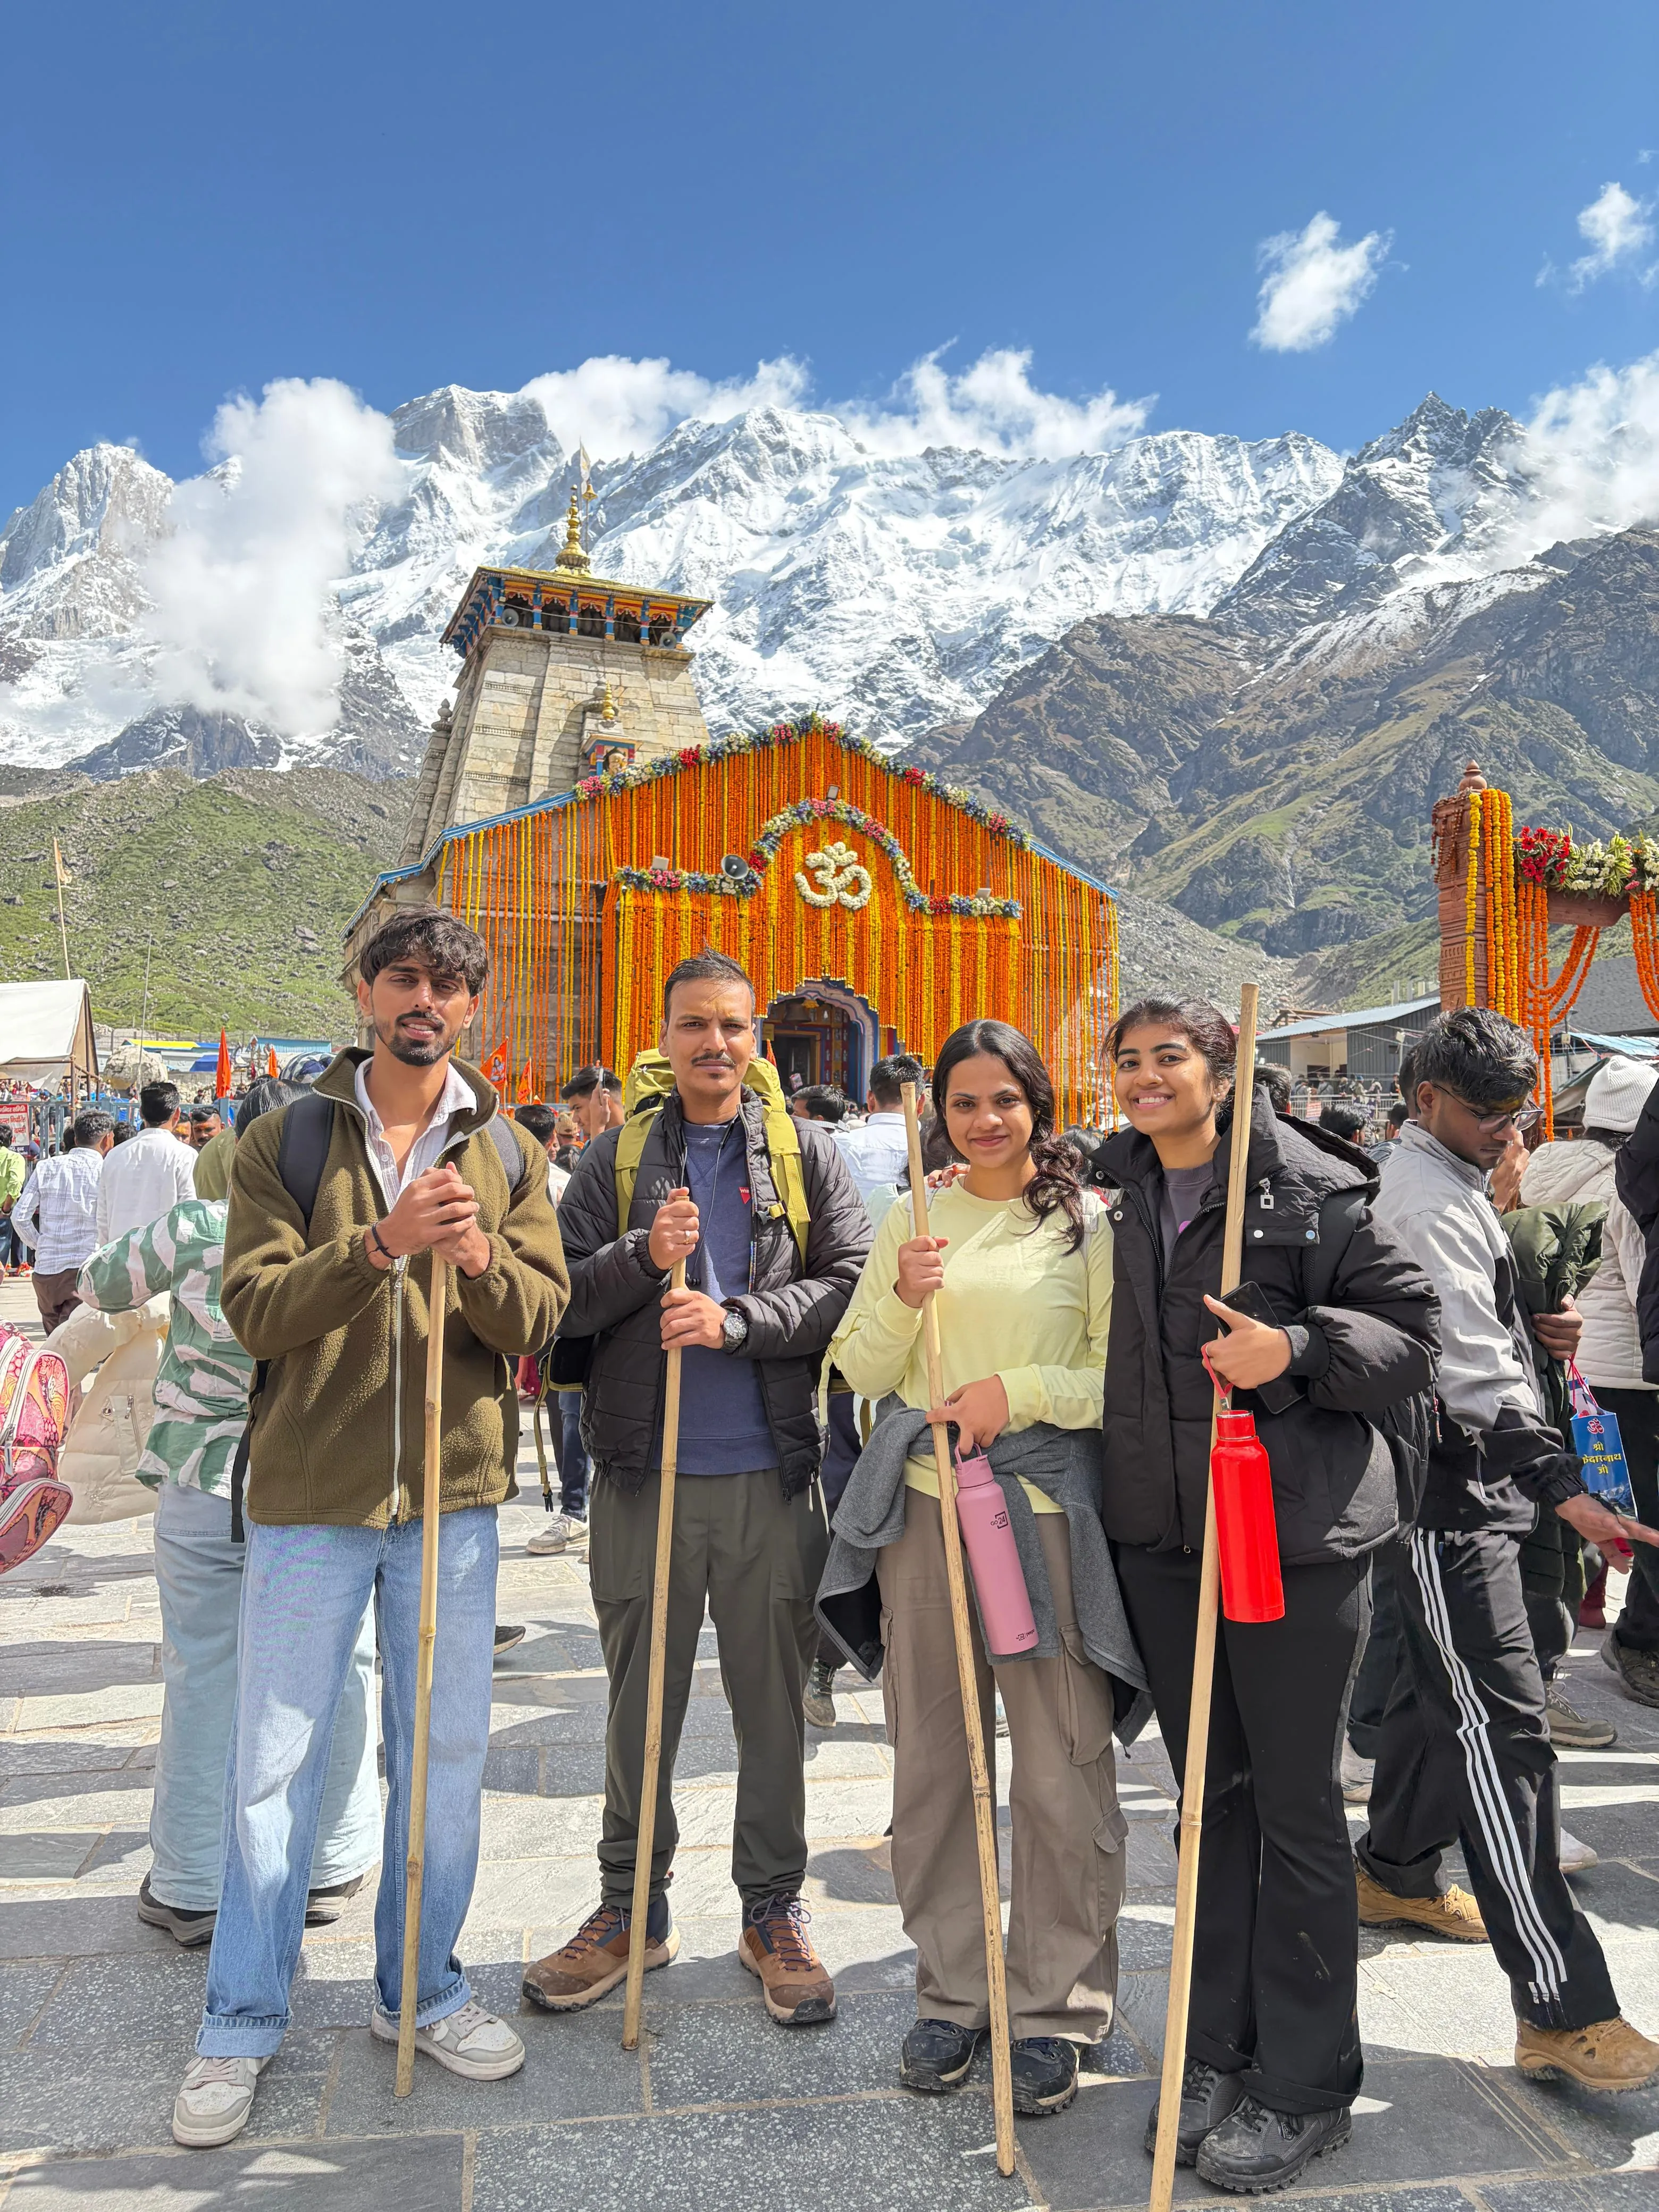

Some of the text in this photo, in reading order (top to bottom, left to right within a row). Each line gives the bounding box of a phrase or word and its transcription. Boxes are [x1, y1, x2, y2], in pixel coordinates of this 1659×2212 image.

[1593, 1441, 1604, 1451] श्री
[1597, 1463, 1608, 1474] जी
[998, 1515, 1006, 1524] 24
